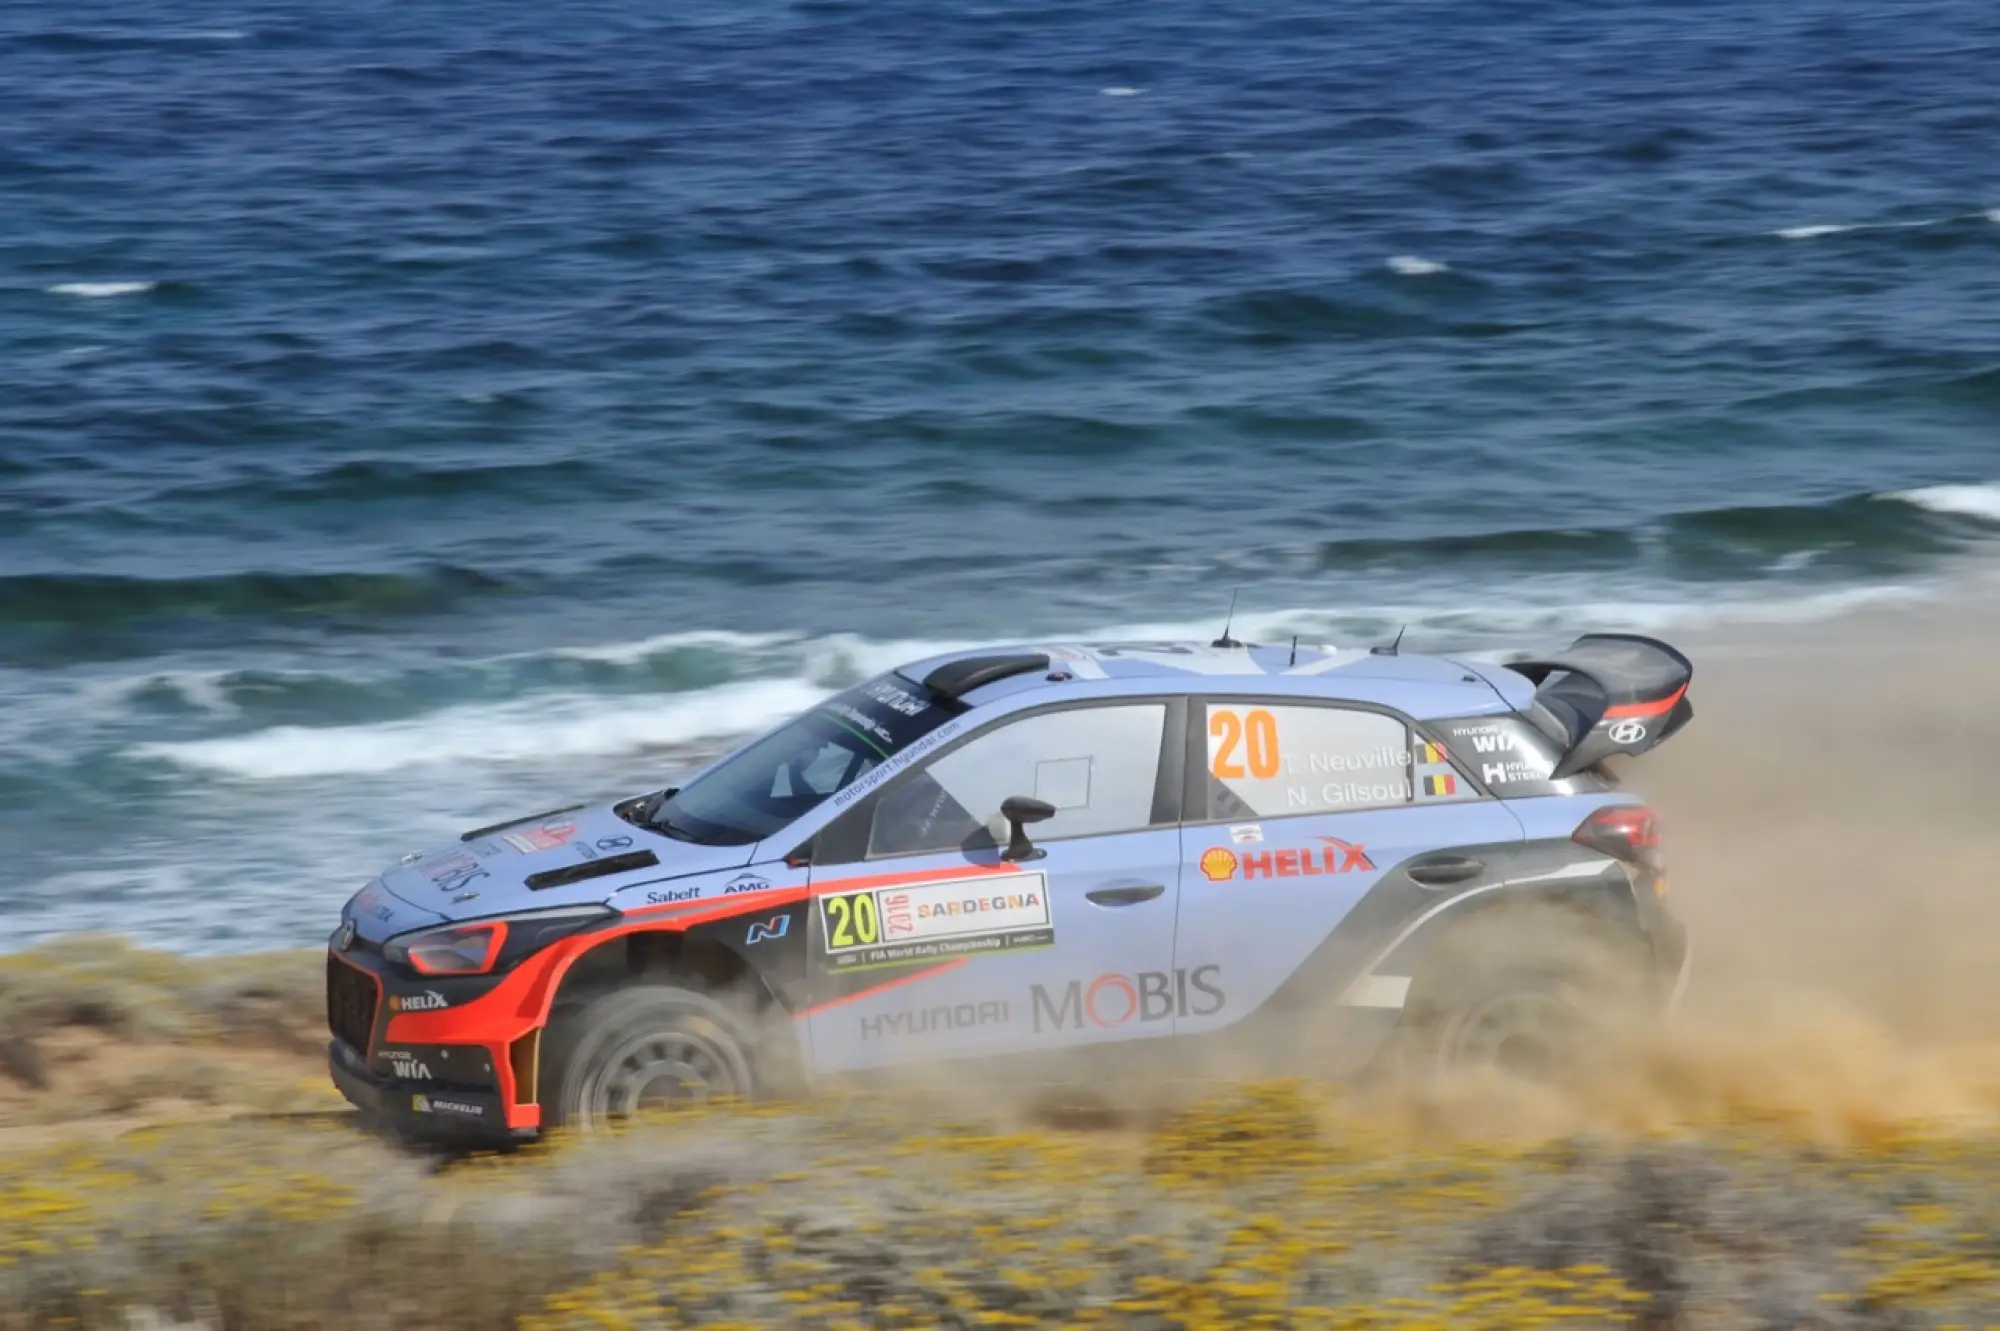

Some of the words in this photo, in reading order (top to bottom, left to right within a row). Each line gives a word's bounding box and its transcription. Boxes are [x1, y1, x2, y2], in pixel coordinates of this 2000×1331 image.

[1209, 709, 1280, 780] 20
[1310, 746, 1411, 773] Neuville
[1287, 786, 1314, 808] N.
[1322, 777, 1411, 806] Gilsoul
[1241, 838, 1377, 881] HELIX
[827, 891, 878, 948] 20
[884, 894, 914, 935] 2016
[916, 892, 1040, 919] SARDEGNA
[869, 949, 888, 961] FIA
[888, 945, 914, 959] World
[916, 943, 938, 958] Rally
[939, 937, 1001, 954] Championship
[401, 990, 448, 1011] HELIX
[860, 1000, 1011, 1041] HYUNDAI
[1029, 963, 1226, 1034] MOBIS
[432, 1100, 484, 1116] MICHELIN
